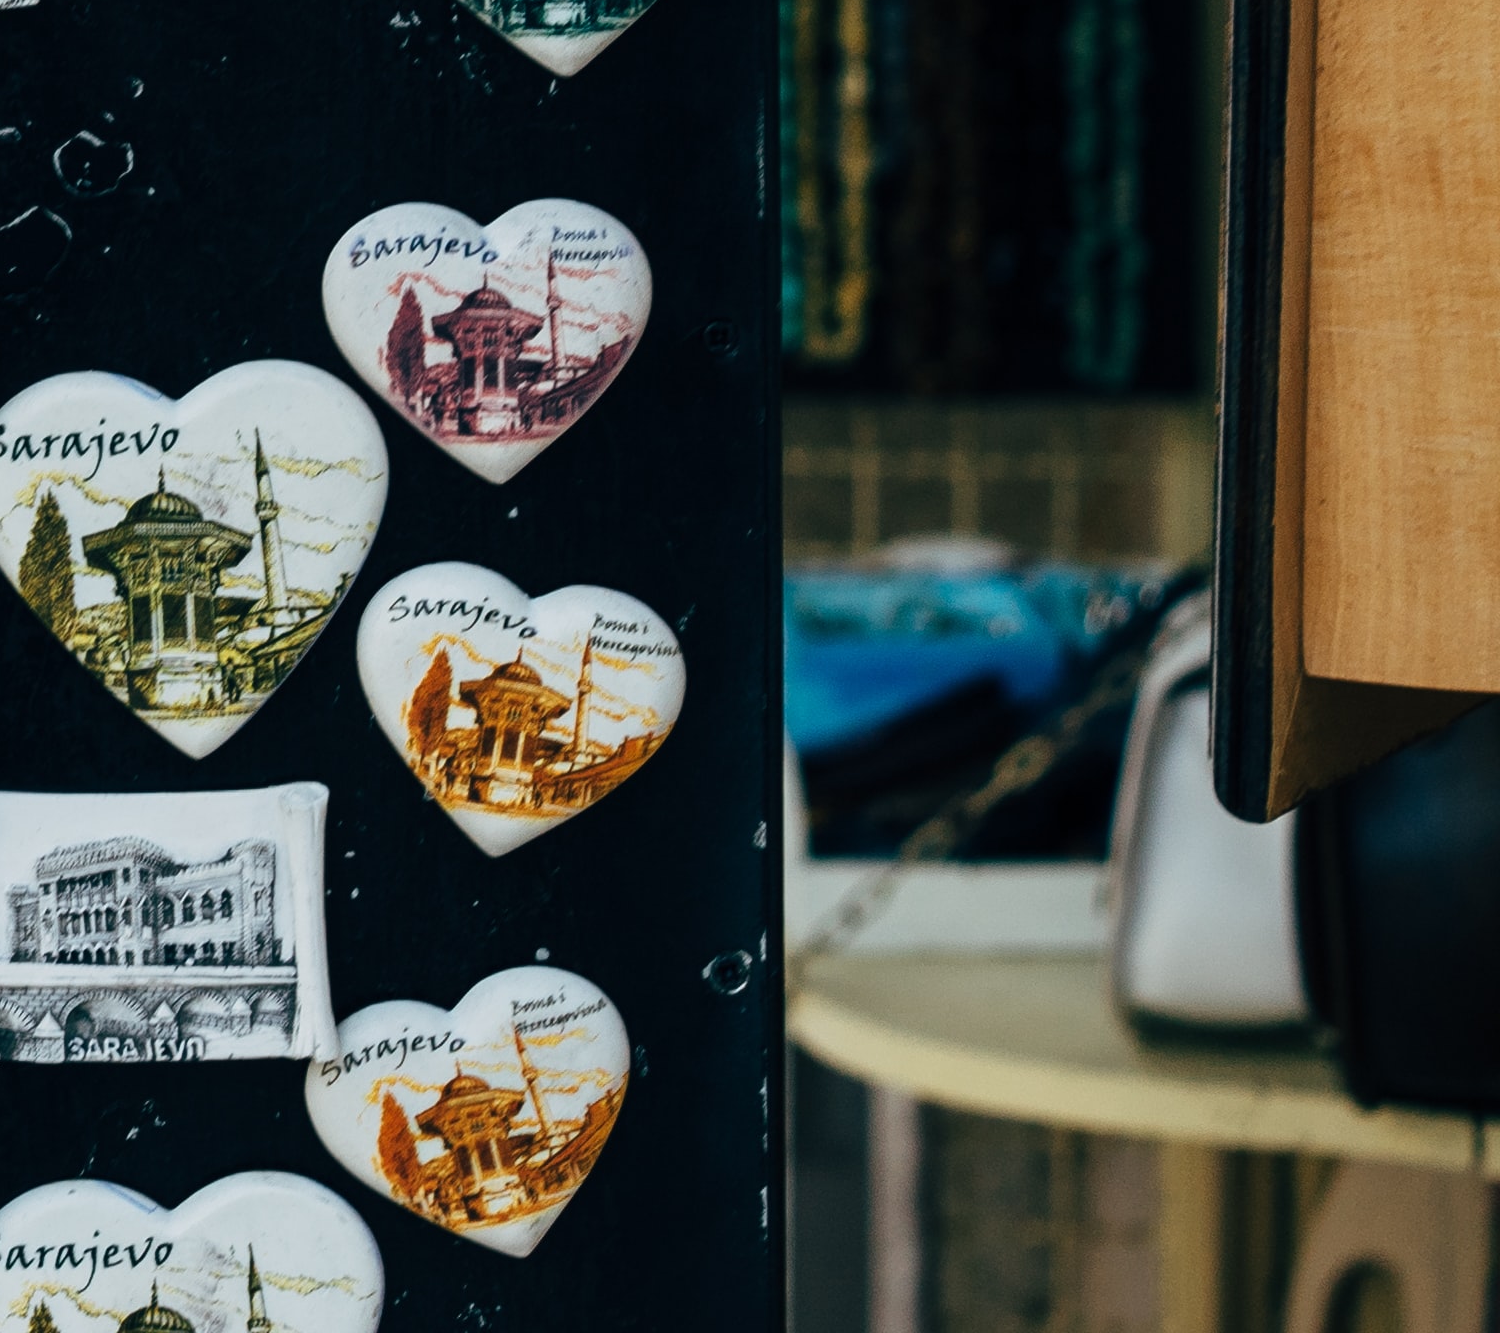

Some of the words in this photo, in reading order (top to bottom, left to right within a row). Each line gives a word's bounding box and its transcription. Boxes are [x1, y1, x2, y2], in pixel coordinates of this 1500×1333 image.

[350, 226, 499, 268] Sarajevo
[388, 595, 538, 639] Sarajevo
[67, 1035, 206, 1062] SARAJEVO
[321, 1027, 466, 1086] Sarajevo
